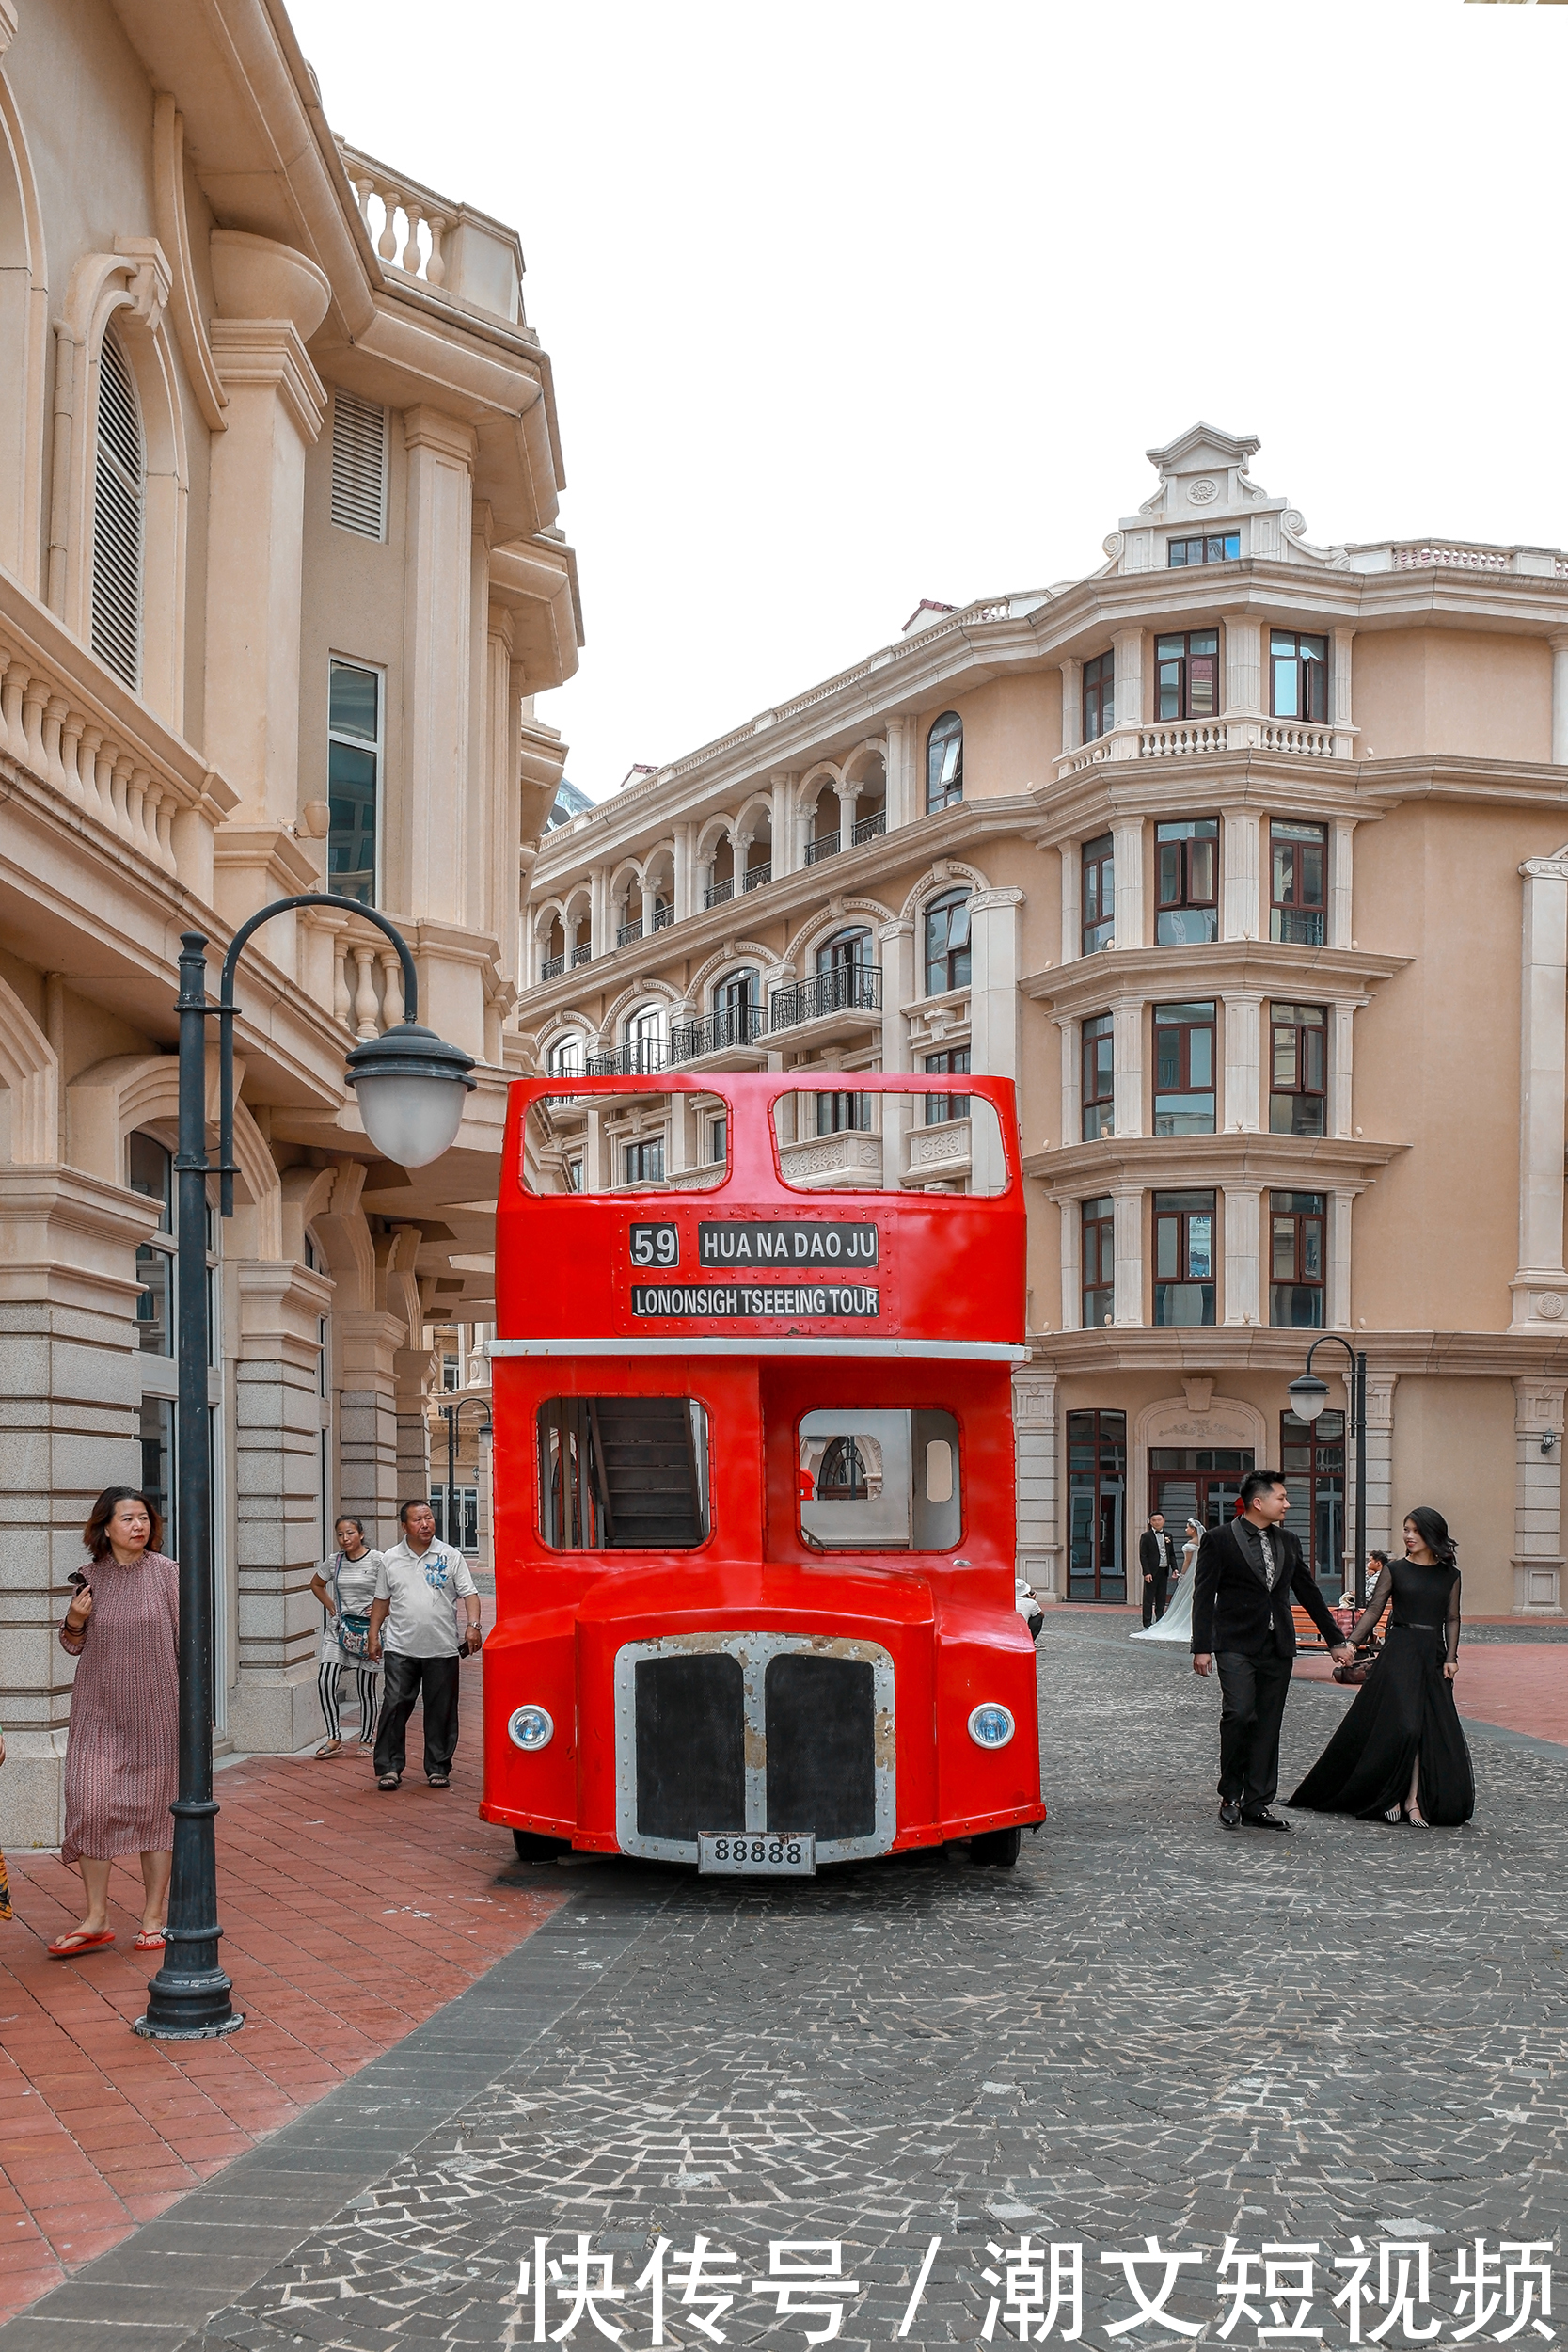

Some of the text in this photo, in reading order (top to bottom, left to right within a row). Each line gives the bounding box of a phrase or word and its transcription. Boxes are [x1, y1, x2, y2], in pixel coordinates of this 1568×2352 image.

[635, 1229, 674, 1263] 59
[705, 1232, 875, 1258] HUA NA DAO JU
[636, 1289, 878, 1313] LONONSIGH TSEEEING TOUR
[715, 1839, 801, 1864] 88888
